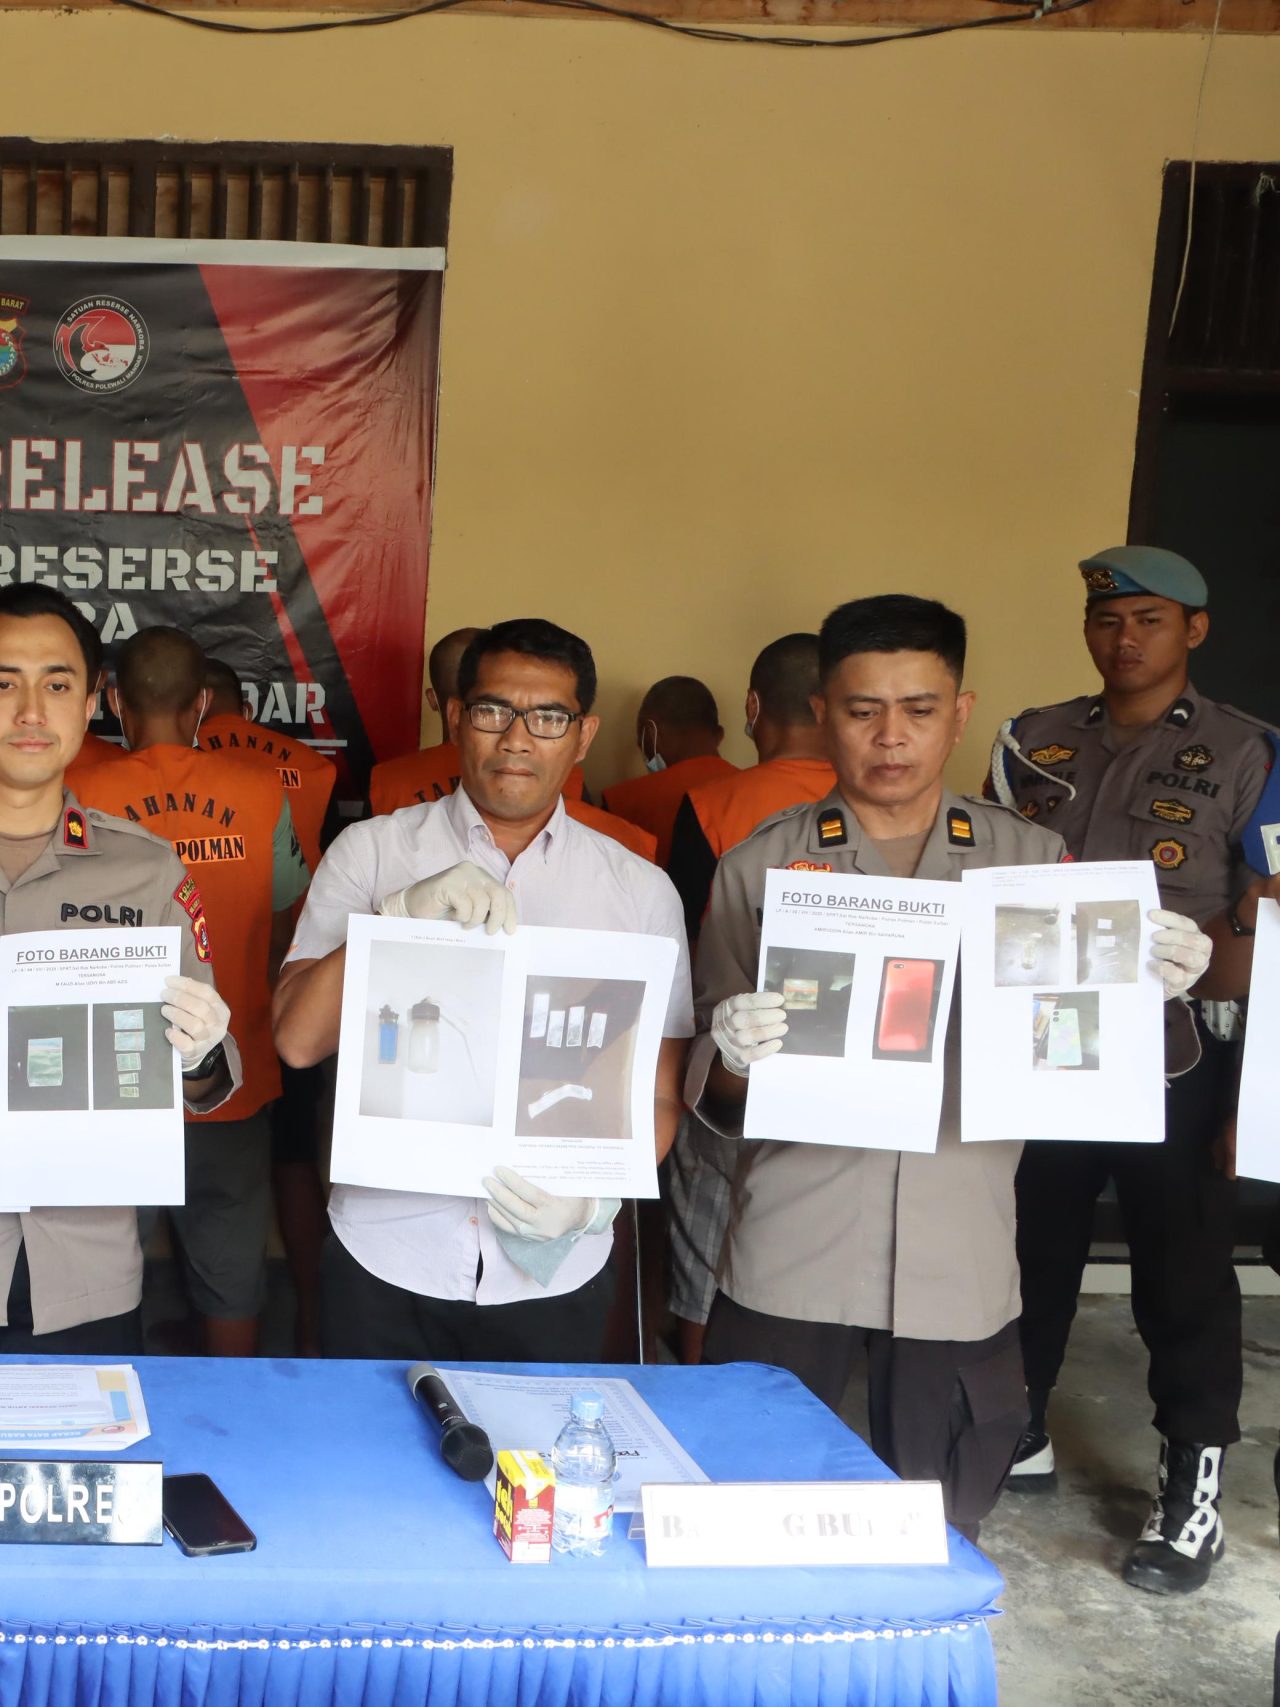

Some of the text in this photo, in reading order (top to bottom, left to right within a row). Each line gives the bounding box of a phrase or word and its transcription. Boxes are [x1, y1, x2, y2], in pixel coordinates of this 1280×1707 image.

[1, 297, 24, 309] BARAT
[67, 300, 144, 350] SATUAN RESERSE NARKOBA
[72, 355, 142, 390] POLRES POLEWALI MANDAR
[1147, 771, 1220, 799] POLRI
[124, 793, 236, 827] AHANAN
[176, 836, 245, 863] POLMAN
[60, 902, 143, 927] POLRI
[782, 891, 945, 915] FOTO BARANG BUKTI
[17, 945, 168, 962] FOTO BARANG BUKTI
